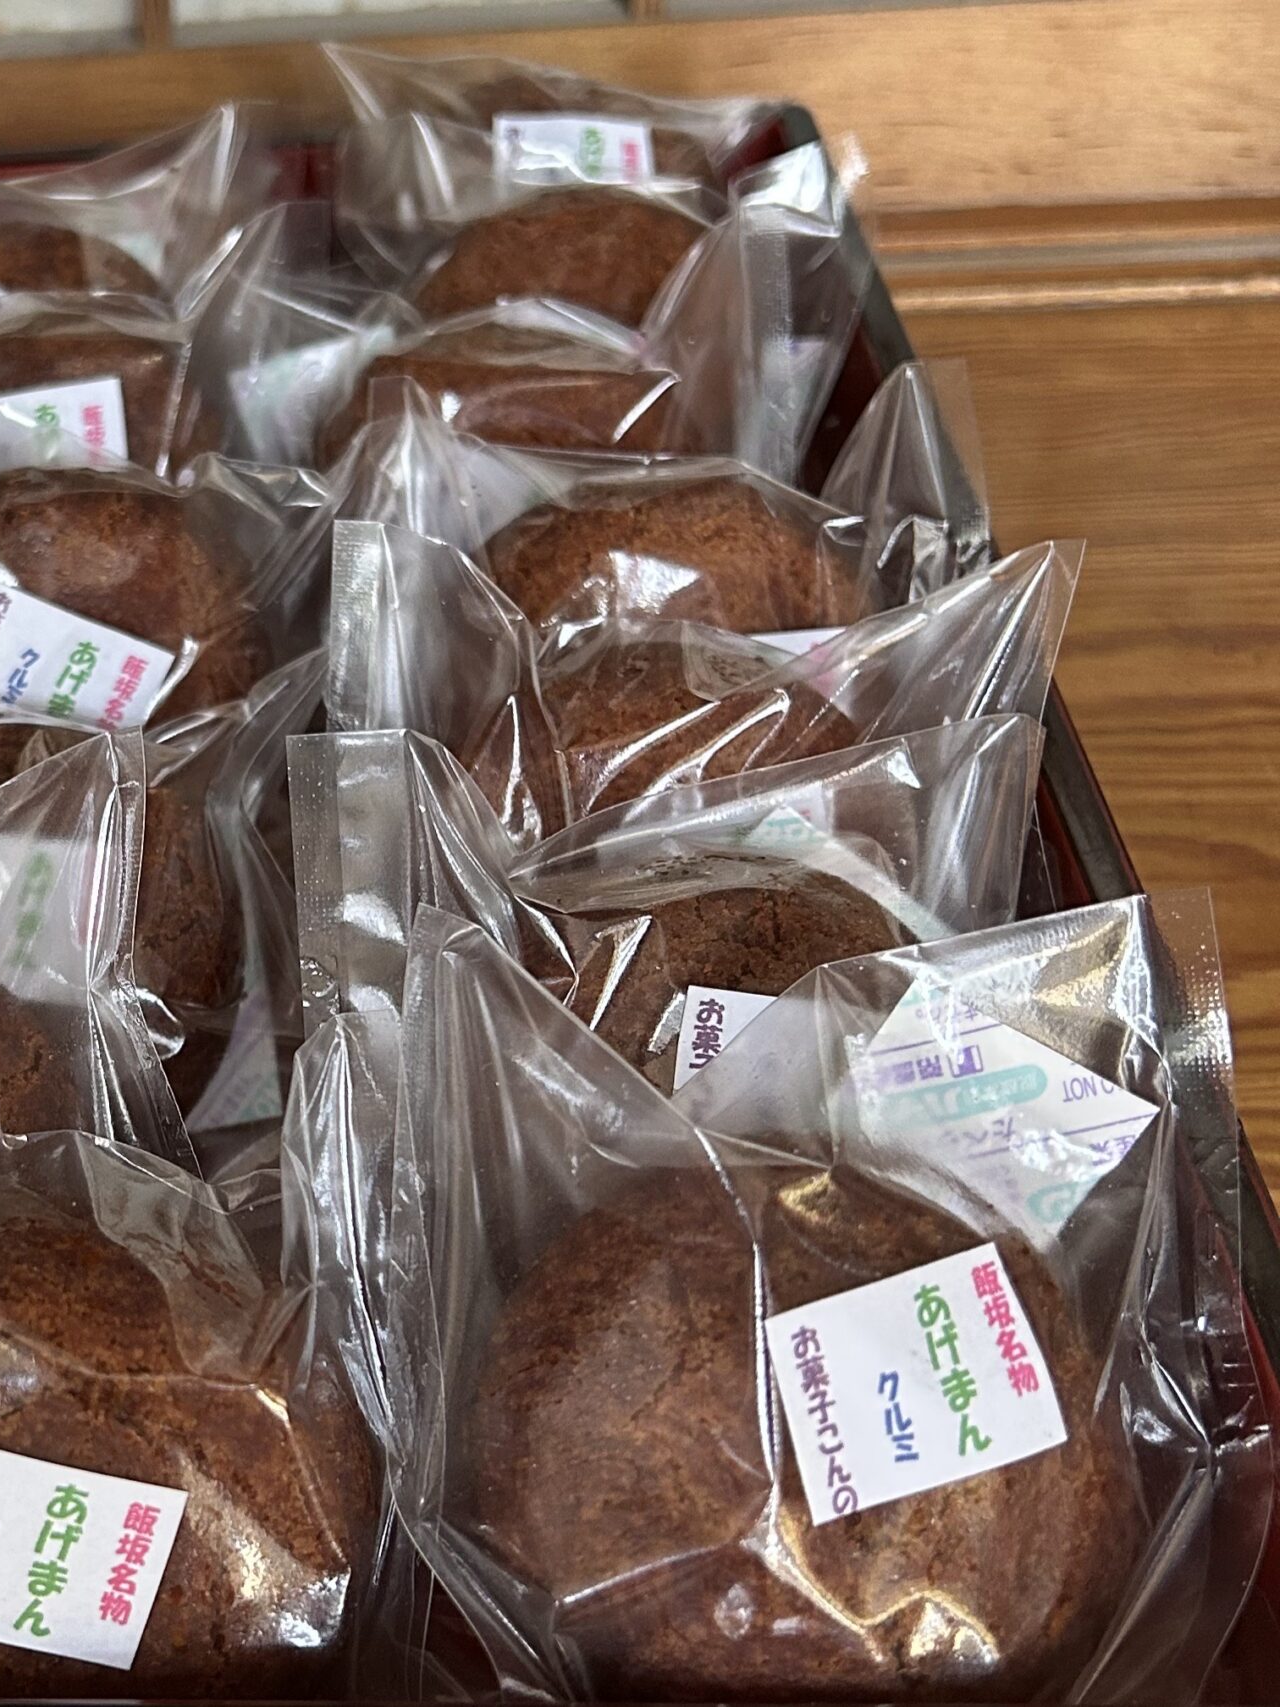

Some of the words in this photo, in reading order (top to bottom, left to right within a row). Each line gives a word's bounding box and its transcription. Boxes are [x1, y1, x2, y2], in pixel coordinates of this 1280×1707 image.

[1, 648, 40, 704] クルミ
[47, 641, 100, 719] あげま
[1062, 1077, 1097, 1103] NOT
[913, 1285, 992, 1457] あげまん
[971, 1261, 1039, 1397] 飯坂名物
[790, 1326, 859, 1515] お菓子こんの
[878, 1371, 919, 1463] クルミ
[13, 1483, 90, 1637] あげまん
[98, 1501, 161, 1626] 飯坂名物
